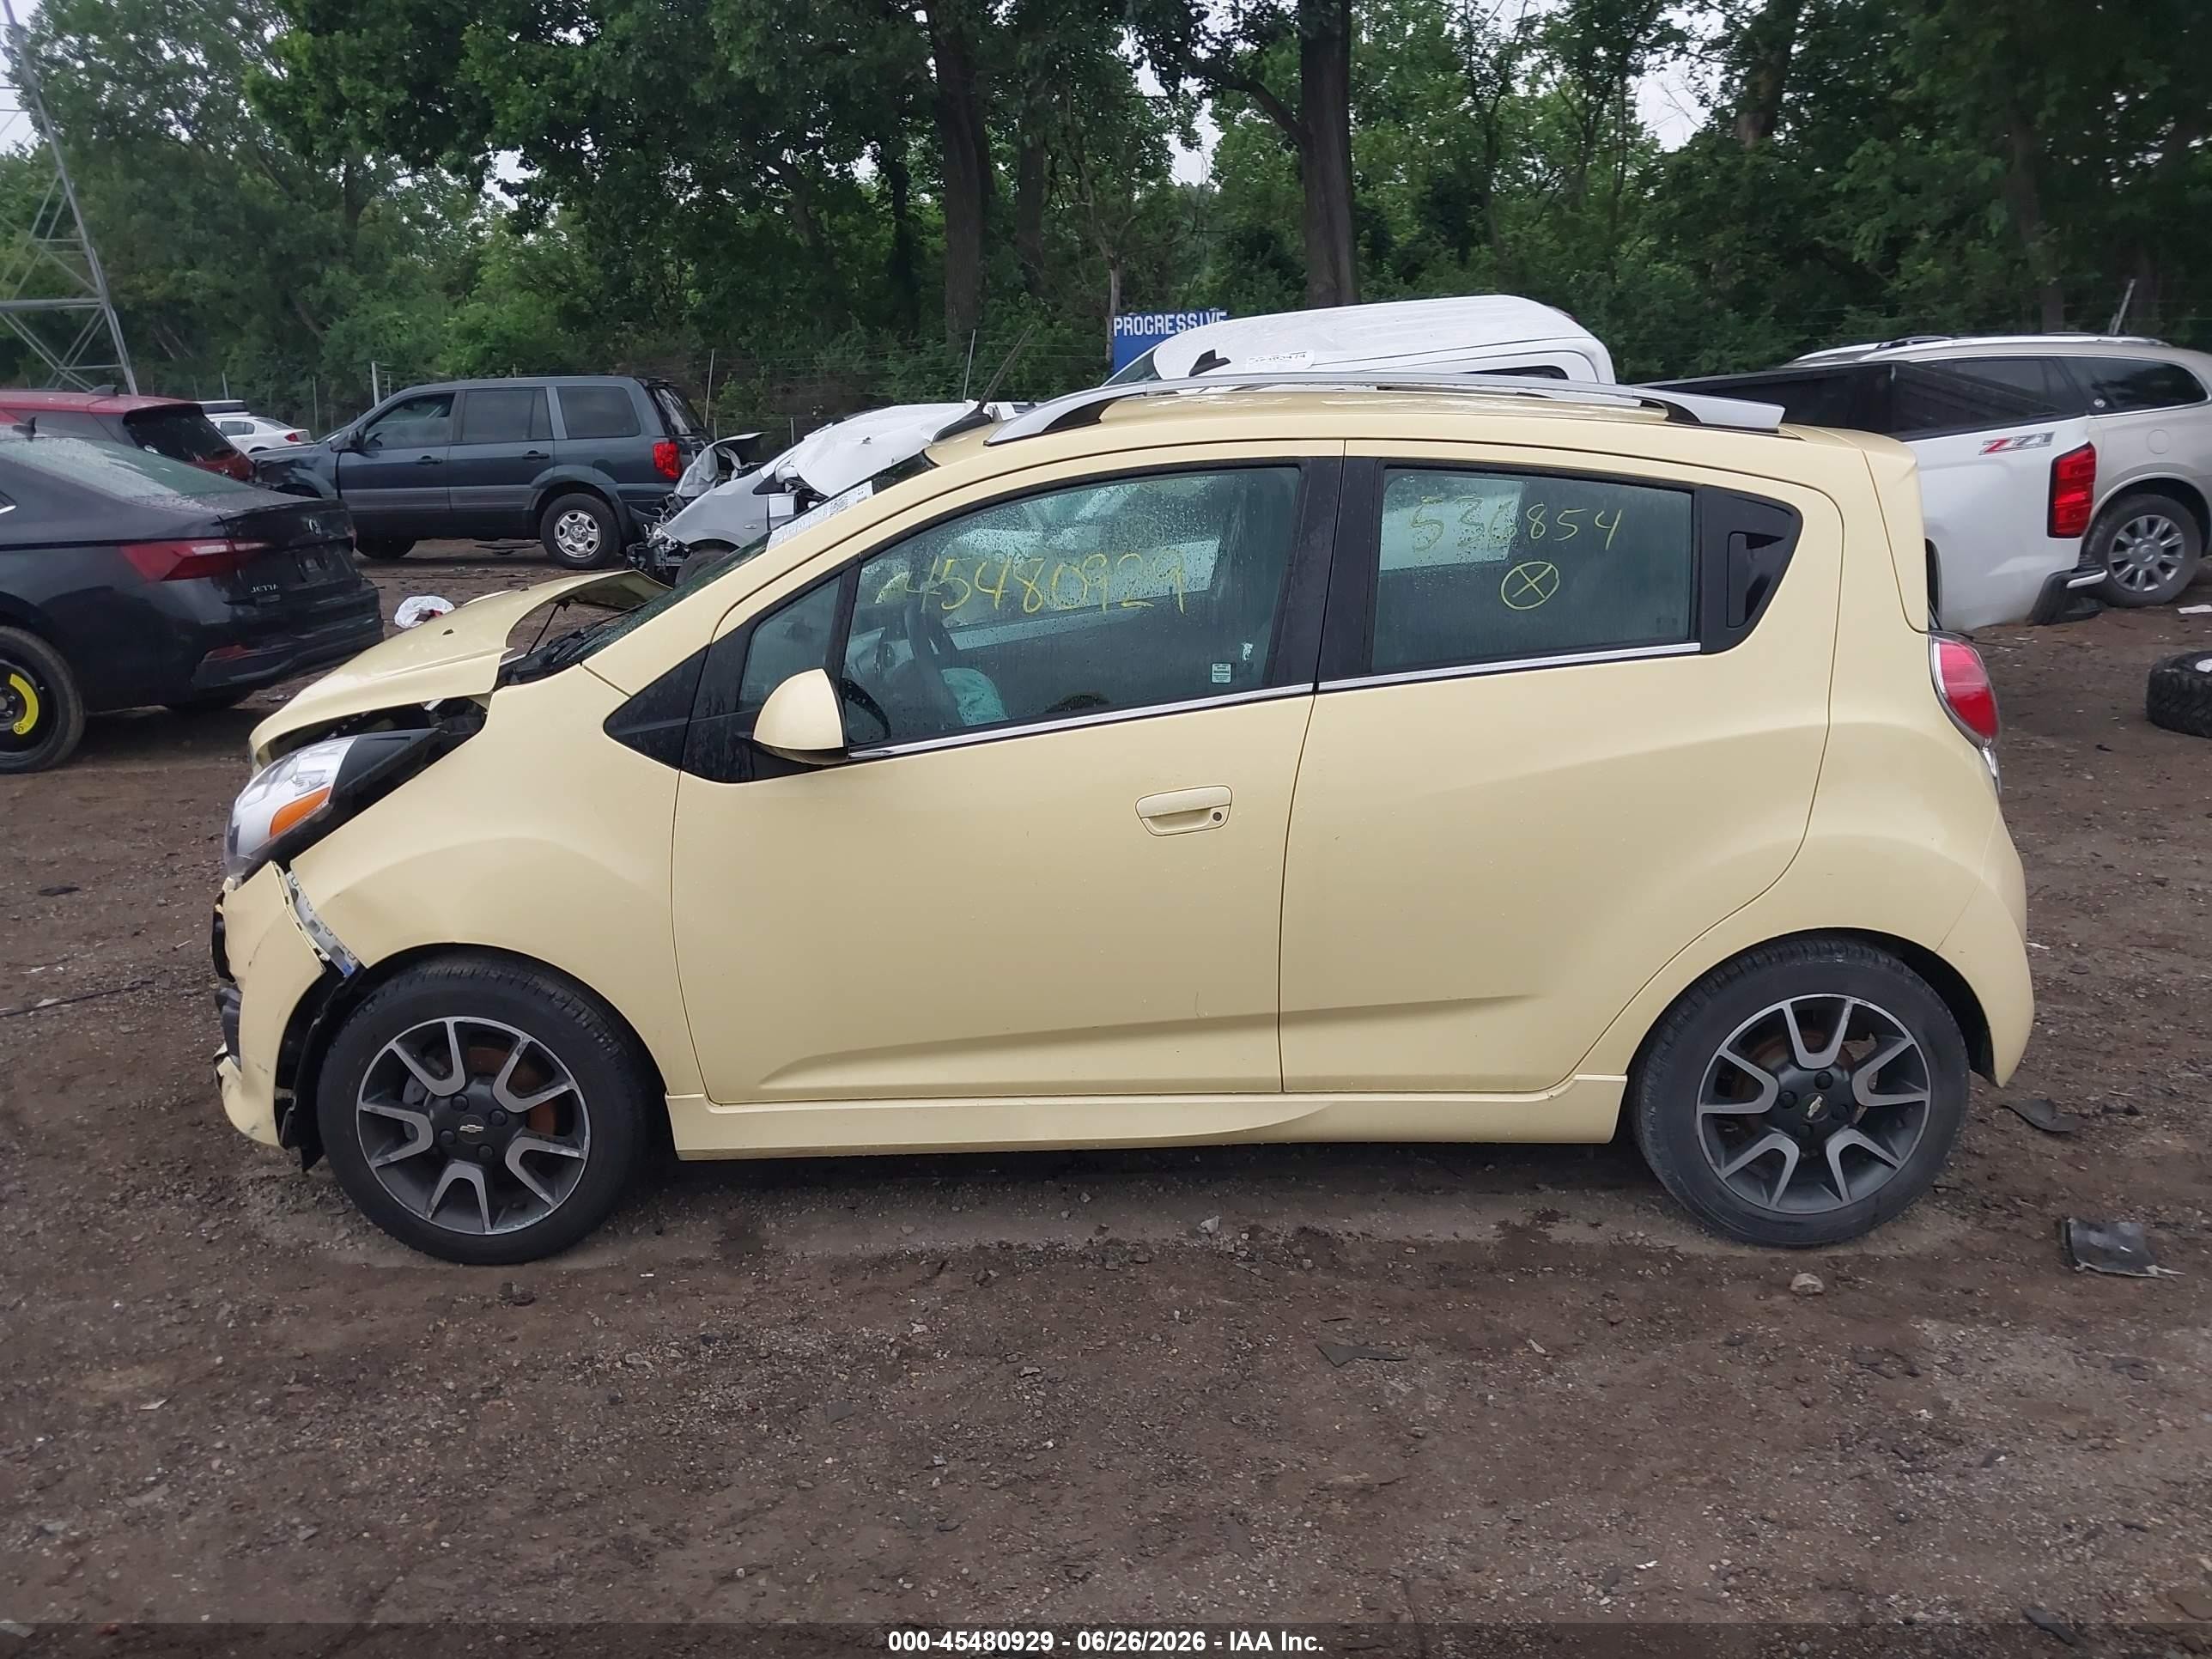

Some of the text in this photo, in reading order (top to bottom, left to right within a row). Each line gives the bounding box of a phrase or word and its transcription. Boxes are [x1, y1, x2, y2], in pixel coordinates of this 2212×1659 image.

[1978, 431, 2056, 455] Z71
[251, 583, 280, 593] JETTA
[904, 552, 1185, 615] 45480929
